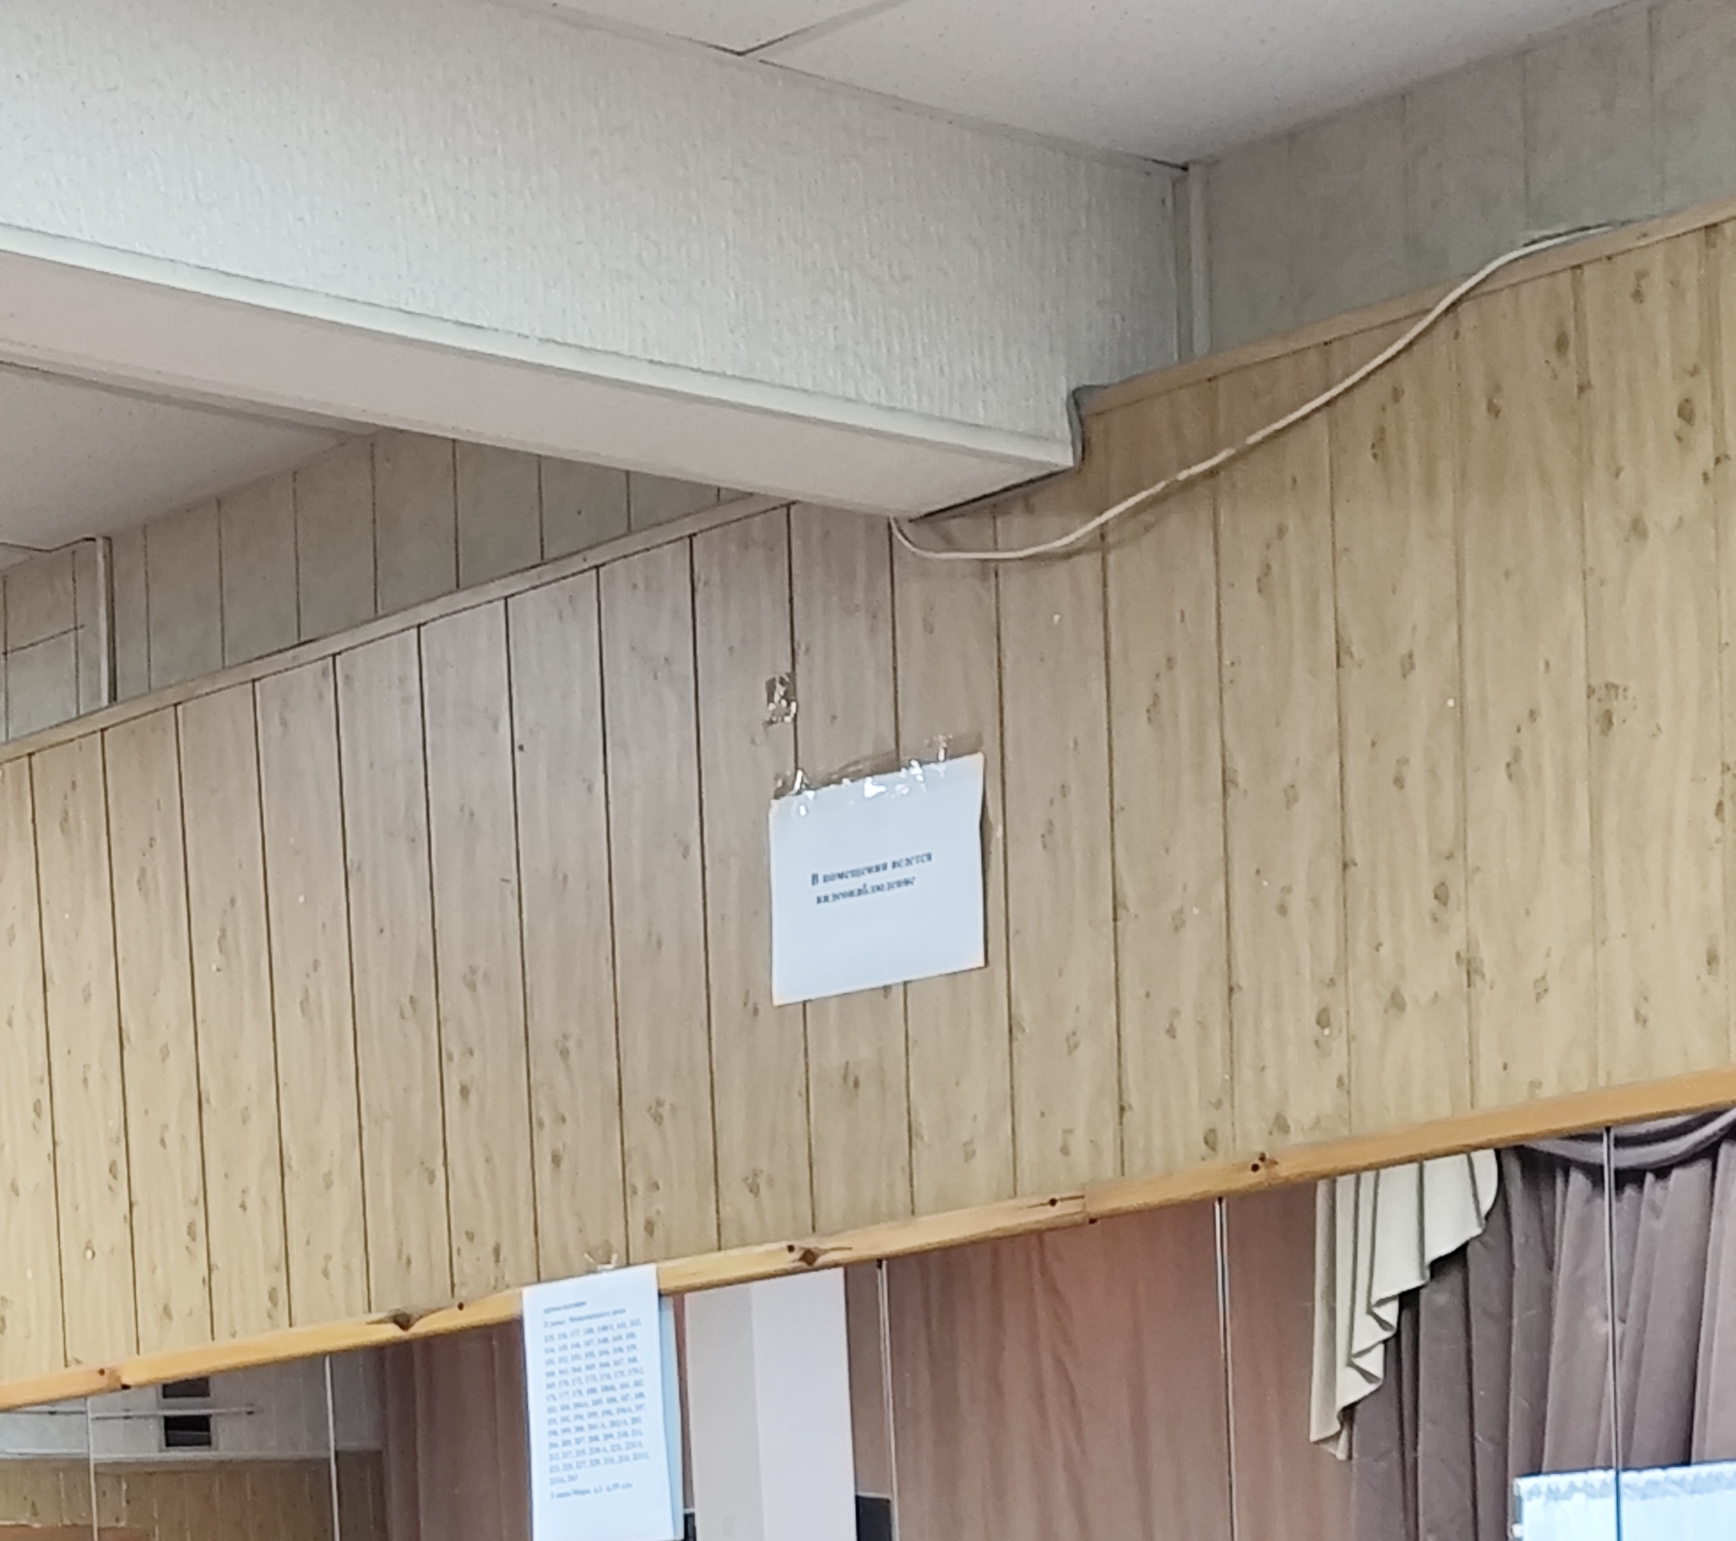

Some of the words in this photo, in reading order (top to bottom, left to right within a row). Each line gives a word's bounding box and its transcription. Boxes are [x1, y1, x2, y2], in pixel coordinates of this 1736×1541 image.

[811, 873, 819, 886] В
[823, 862, 888, 883] помещении
[816, 876, 916, 904] видеонаблюдение
